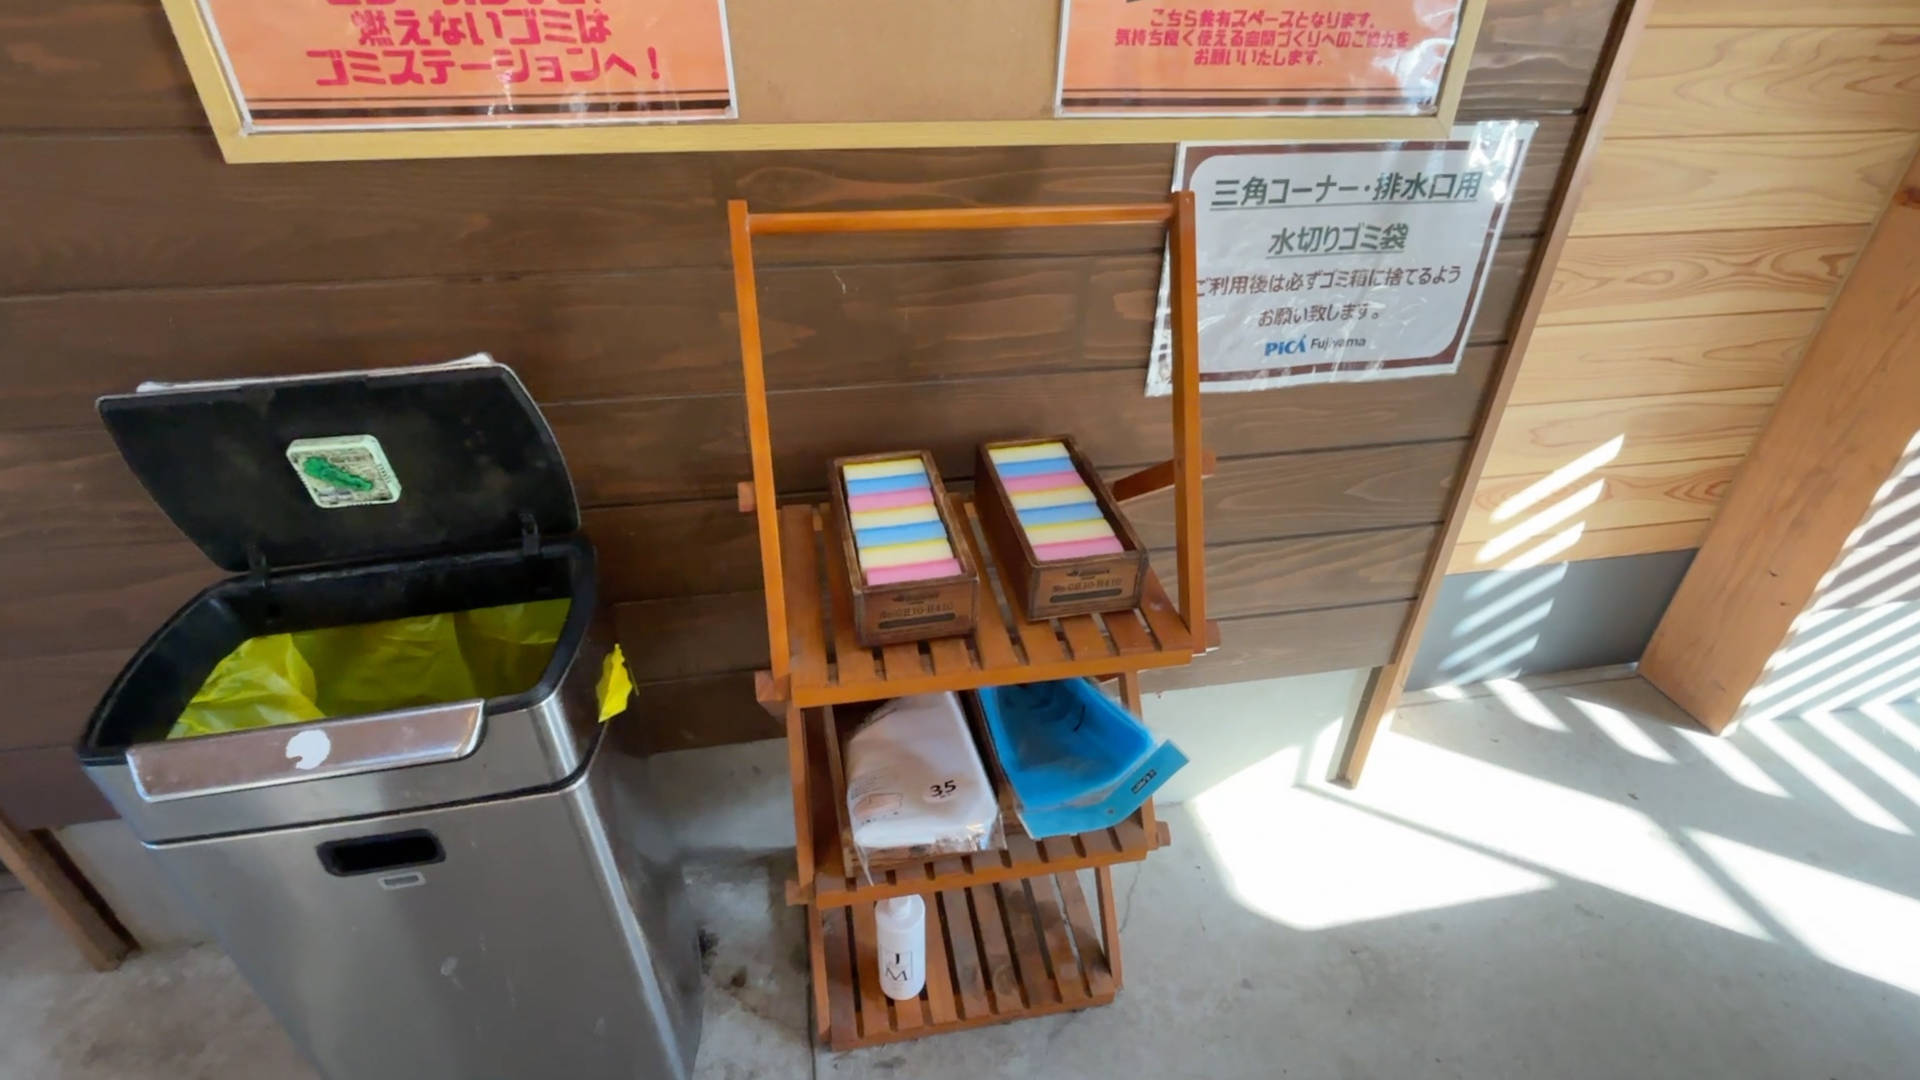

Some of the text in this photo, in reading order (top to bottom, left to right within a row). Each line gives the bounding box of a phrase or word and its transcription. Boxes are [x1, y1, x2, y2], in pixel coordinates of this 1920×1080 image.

[352, 9, 612, 46] 燃えないゴミは
[1211, 171, 1483, 206] 三角コーナー・排水口用
[1269, 223, 1409, 254] 水切りゴミ袋
[1197, 265, 1461, 297] ご利用後は必ずゴミ箱に捨てるよう
[1258, 302, 1379, 327] お願い致します。
